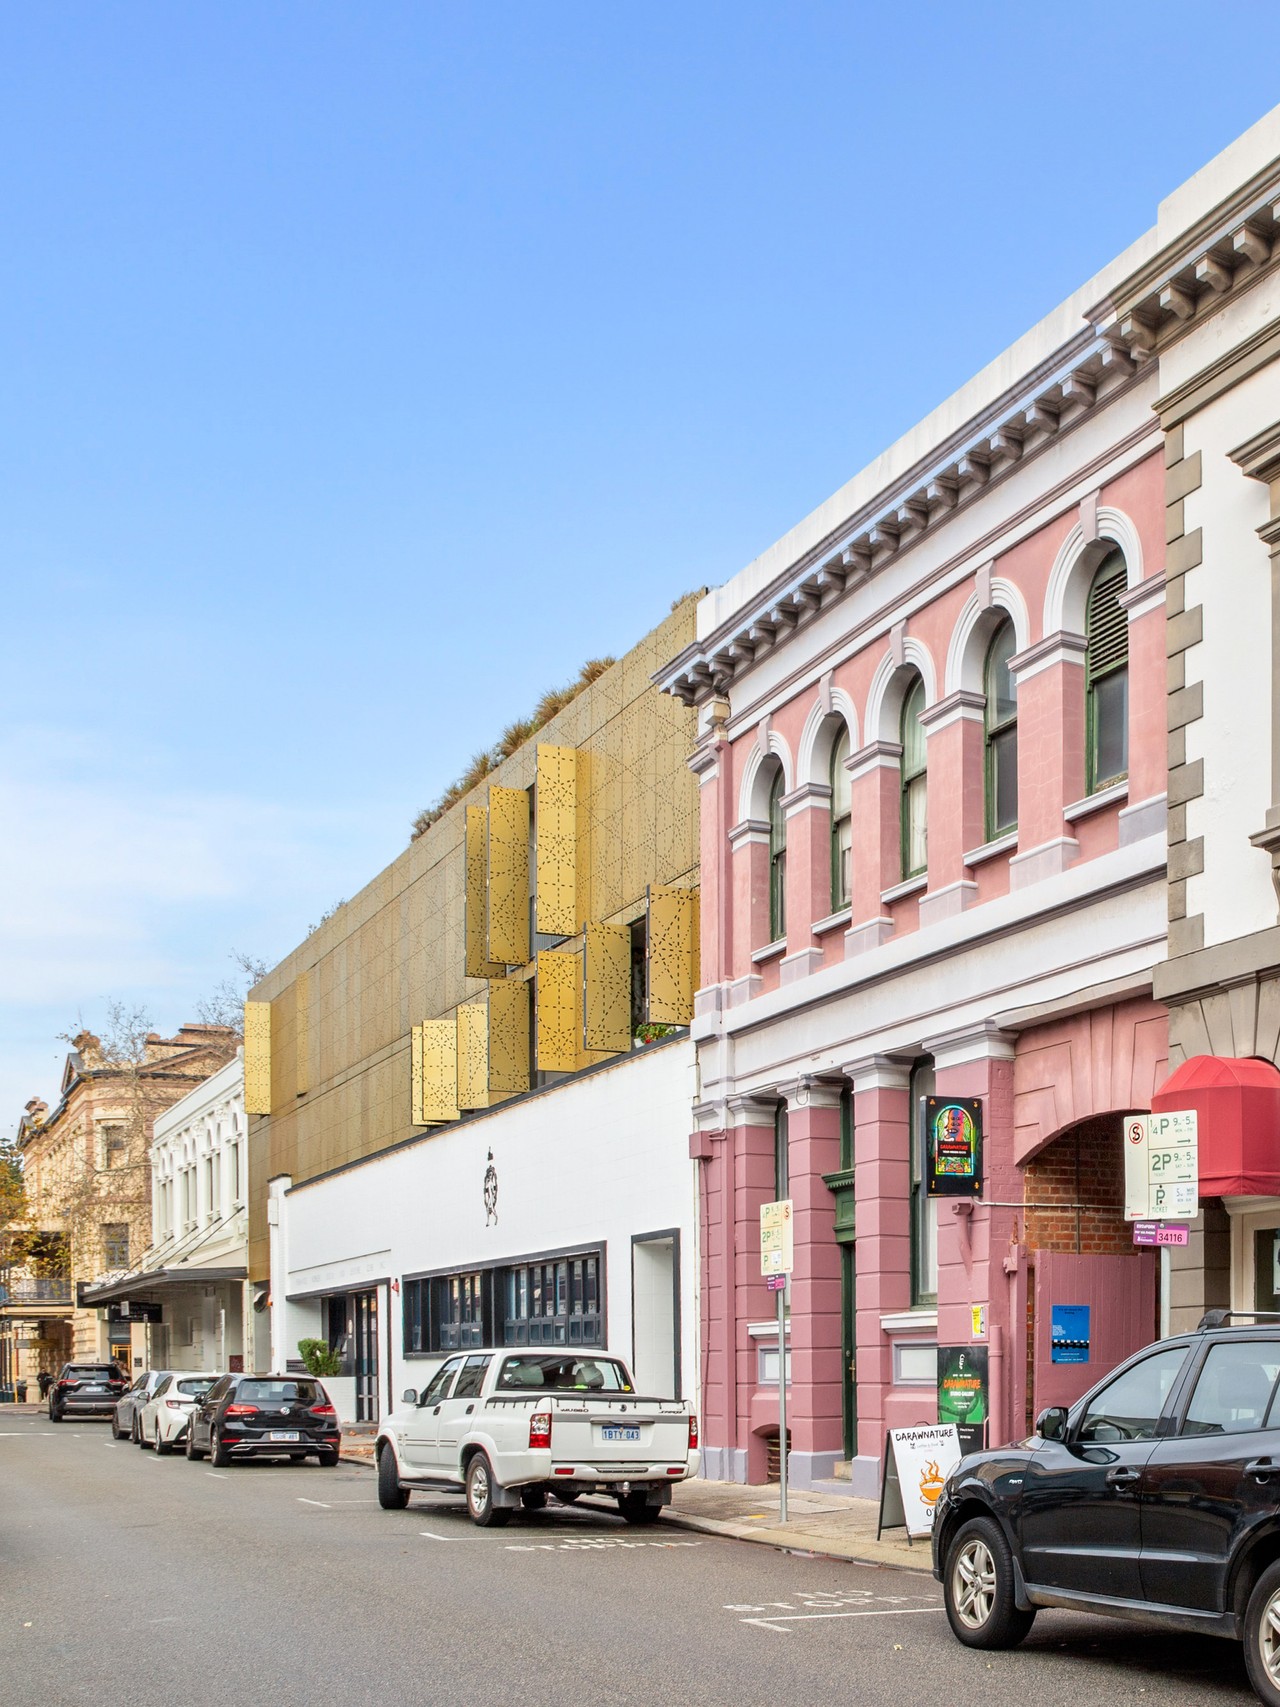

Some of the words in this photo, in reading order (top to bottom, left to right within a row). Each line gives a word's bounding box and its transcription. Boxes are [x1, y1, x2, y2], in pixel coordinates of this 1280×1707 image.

[1152, 1153, 1172, 1171] 2P
[1158, 1233, 1183, 1242] 34116
[896, 1428, 954, 1442] DARAWNATURE
